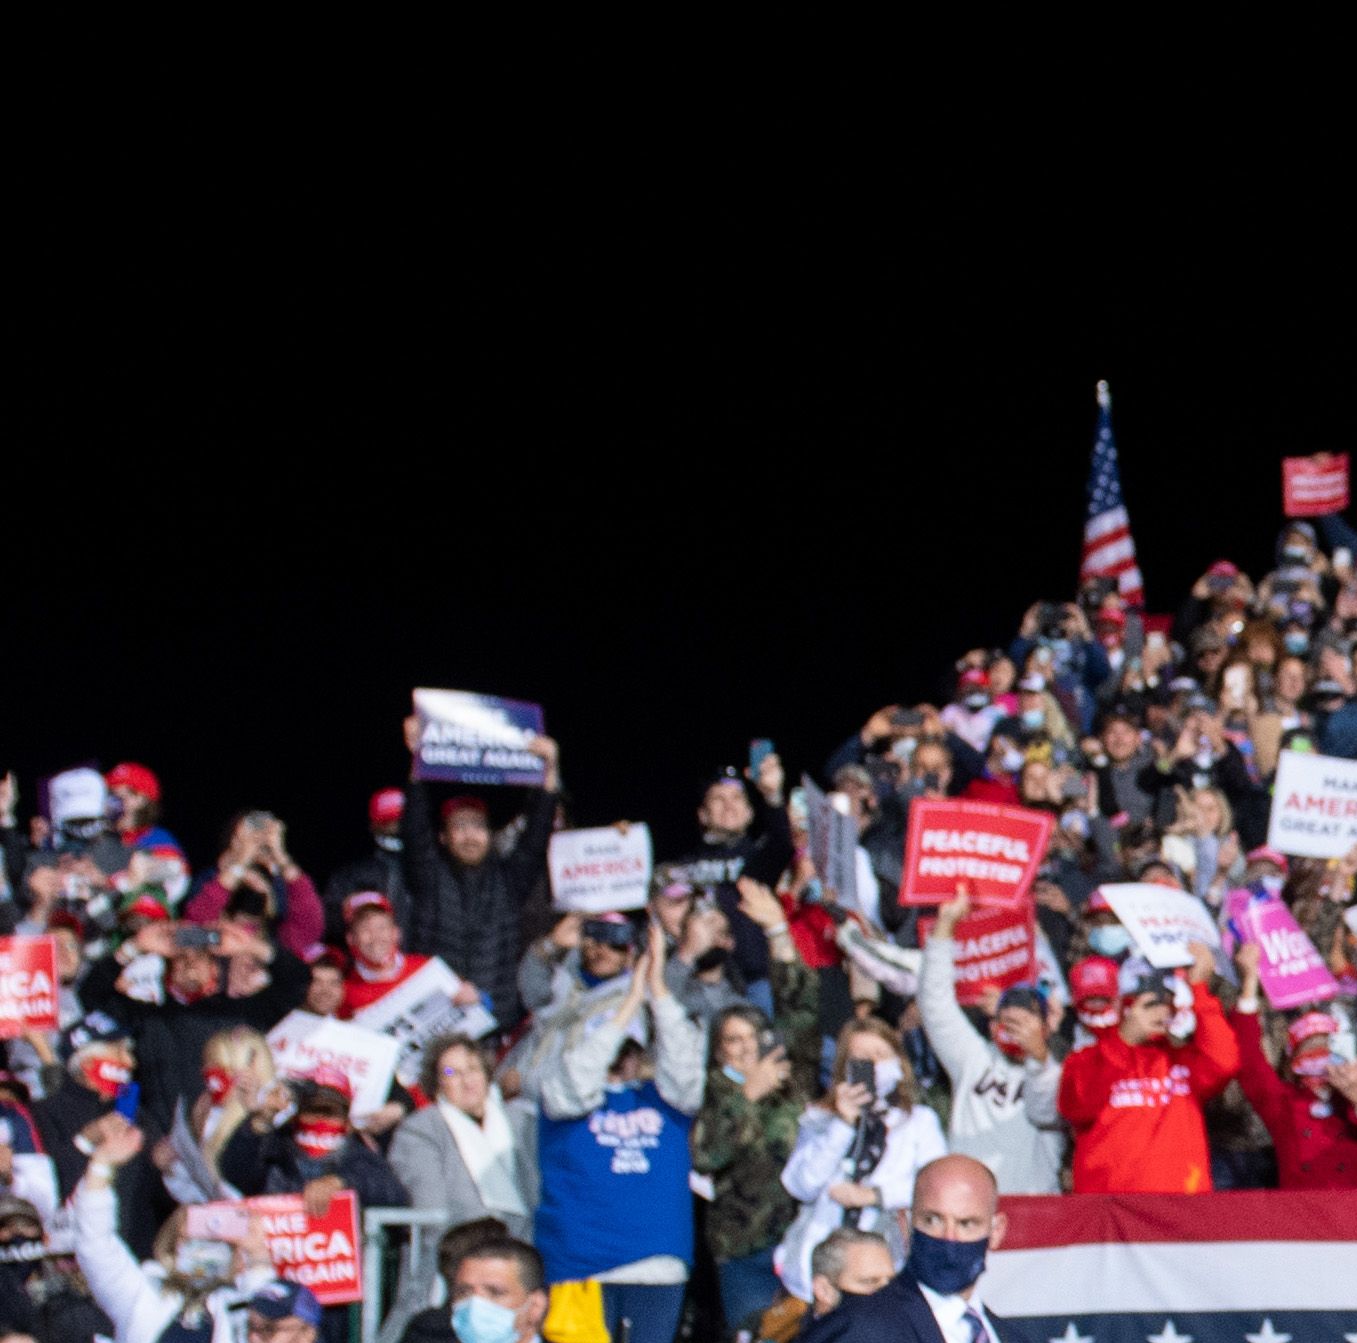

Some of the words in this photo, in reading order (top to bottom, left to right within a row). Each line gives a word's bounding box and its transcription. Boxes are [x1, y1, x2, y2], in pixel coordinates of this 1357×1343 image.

[1279, 818, 1341, 834] GREAT
[921, 829, 1030, 862] PEACEFUL
[561, 857, 644, 881] AMERICA
[917, 856, 1024, 885] PROTESTER
[954, 925, 1029, 958] EACEFUL
[261, 1213, 307, 1232] AKE
[268, 1229, 353, 1263] RICA
